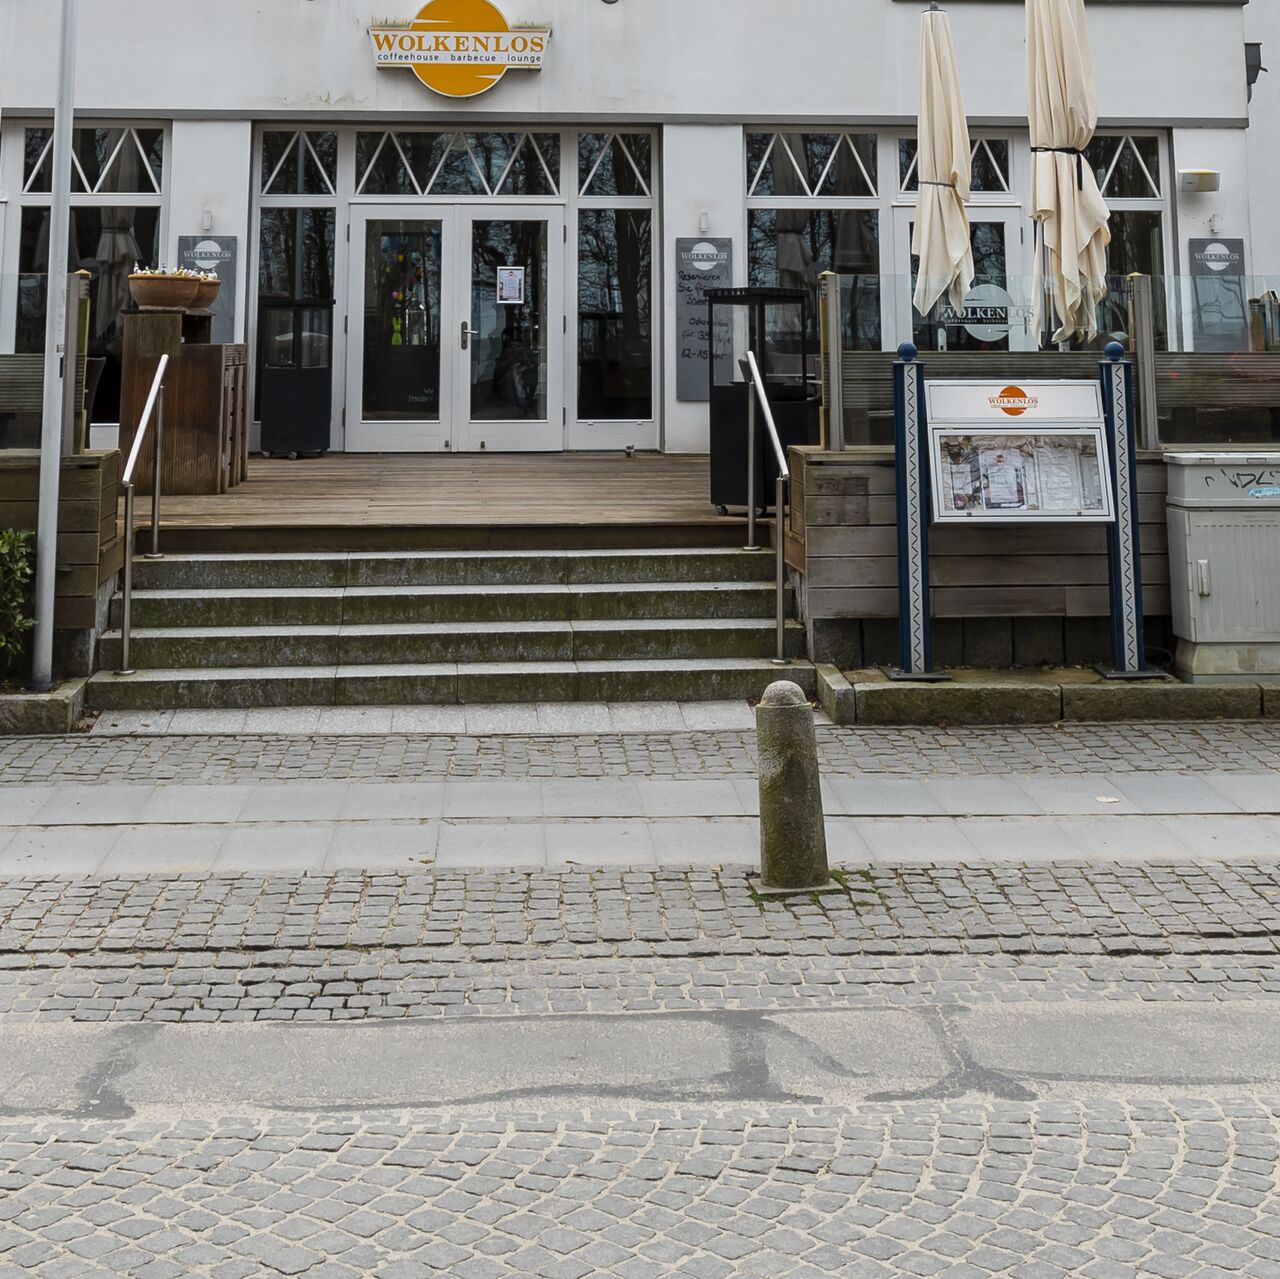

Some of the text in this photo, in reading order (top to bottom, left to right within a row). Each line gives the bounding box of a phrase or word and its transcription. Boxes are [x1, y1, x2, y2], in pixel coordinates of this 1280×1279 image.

[373, 34, 544, 52] WOLKENLOS
[377, 53, 541, 63] coffeehouse barbecue lounge
